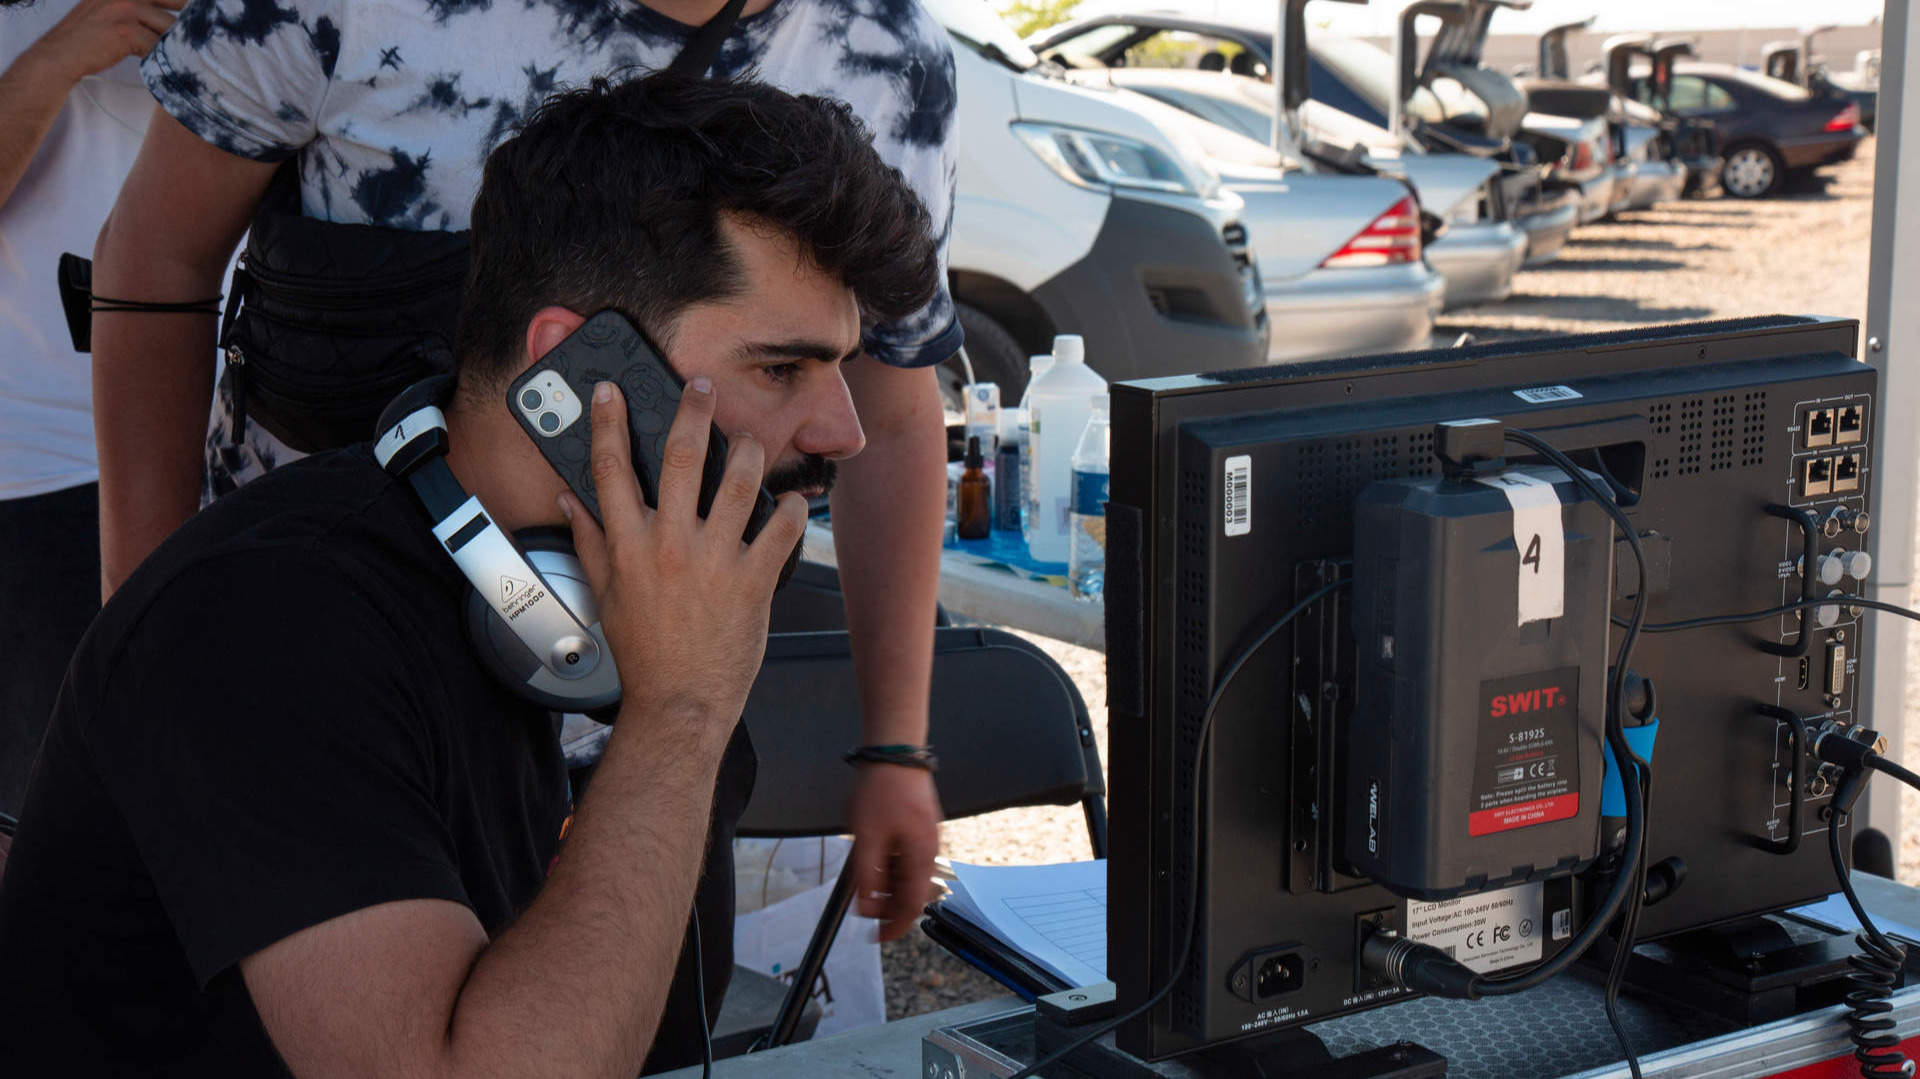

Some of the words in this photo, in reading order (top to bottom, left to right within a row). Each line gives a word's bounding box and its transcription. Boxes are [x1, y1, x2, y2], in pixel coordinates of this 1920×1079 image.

[1522, 533, 1541, 574] 4
[503, 584, 537, 613] behringer
[509, 591, 545, 621] HPM1000
[1491, 687, 1559, 718] SWIT
[1496, 790, 1513, 798] Please
[1538, 782, 1556, 790] battery
[1485, 800, 1498, 809] parts
[1514, 793, 1536, 802] boarding
[1368, 782, 1378, 853] WELAB
[1504, 816, 1520, 824] MADE
[1528, 810, 1544, 820] CHINA
[1424, 904, 1436, 912] LCD
[1438, 899, 1462, 909] Monitor
[1412, 919, 1428, 929] Input
[1412, 932, 1431, 941] Power
[1257, 1012, 1266, 1020] AC
